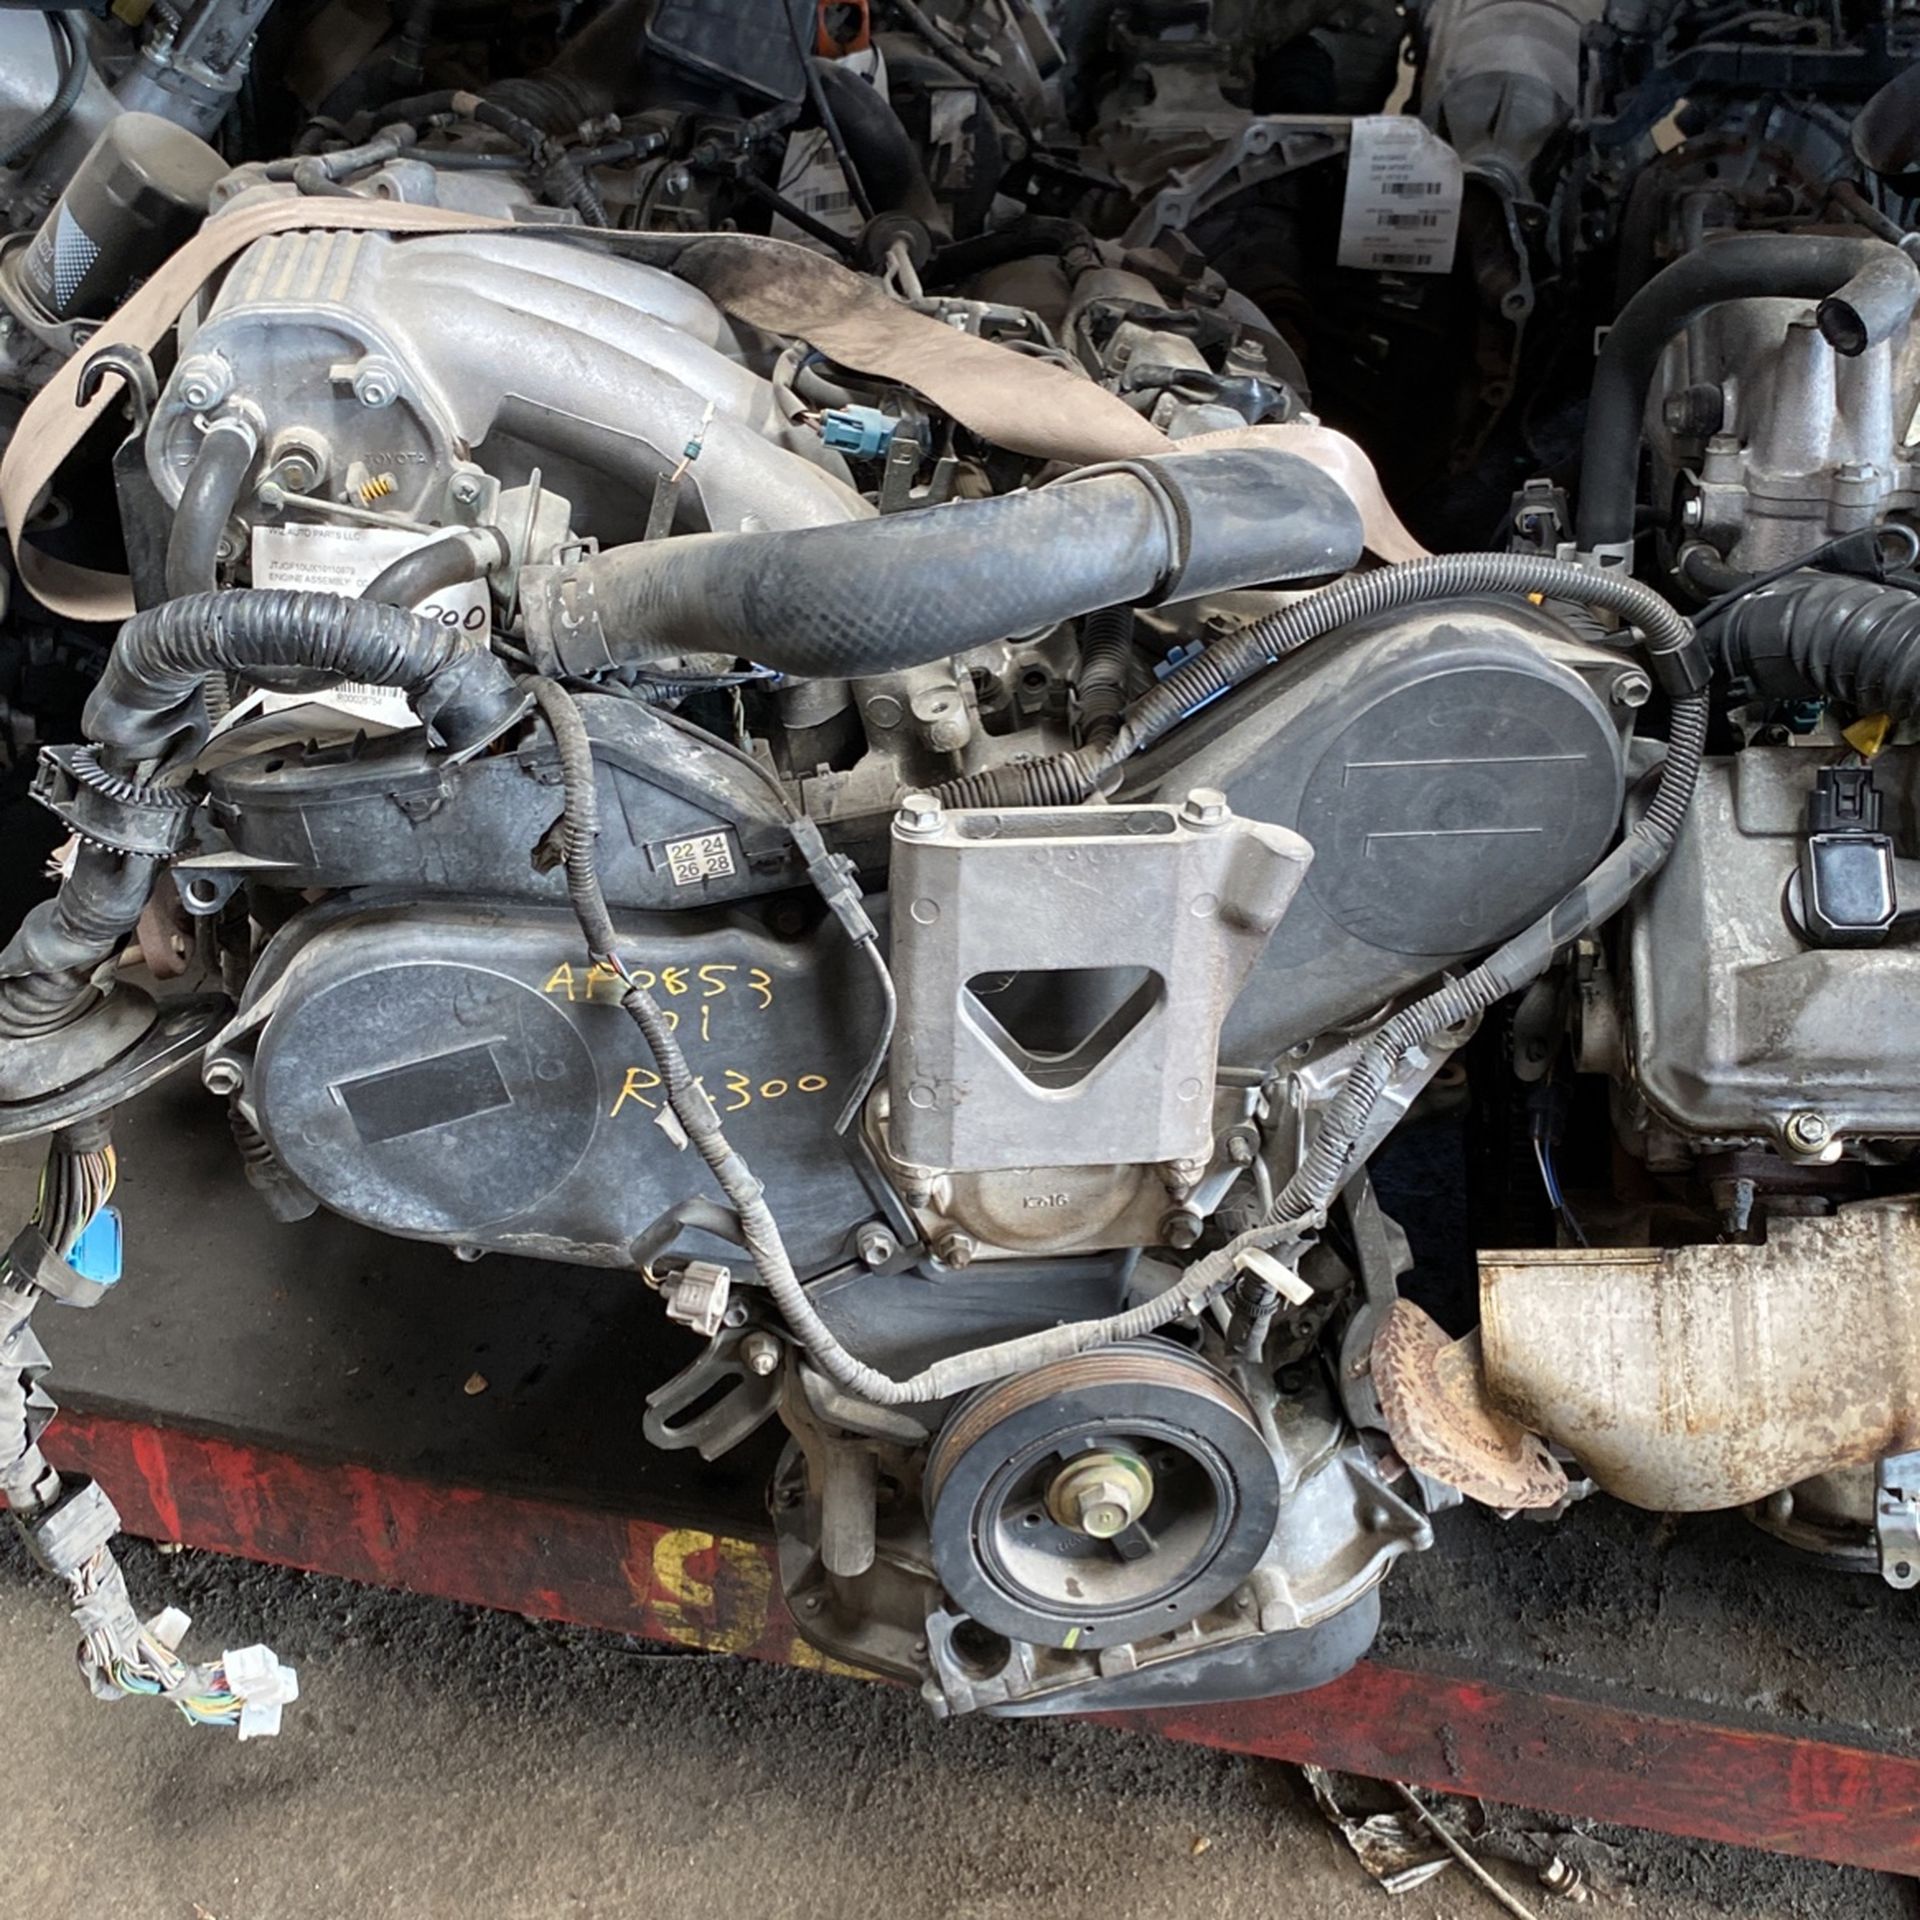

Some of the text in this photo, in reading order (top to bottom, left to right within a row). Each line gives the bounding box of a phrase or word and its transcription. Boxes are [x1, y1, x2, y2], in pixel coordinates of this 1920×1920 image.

[671, 836, 724, 860] 22 24
[676, 855, 730, 879] 26 28
